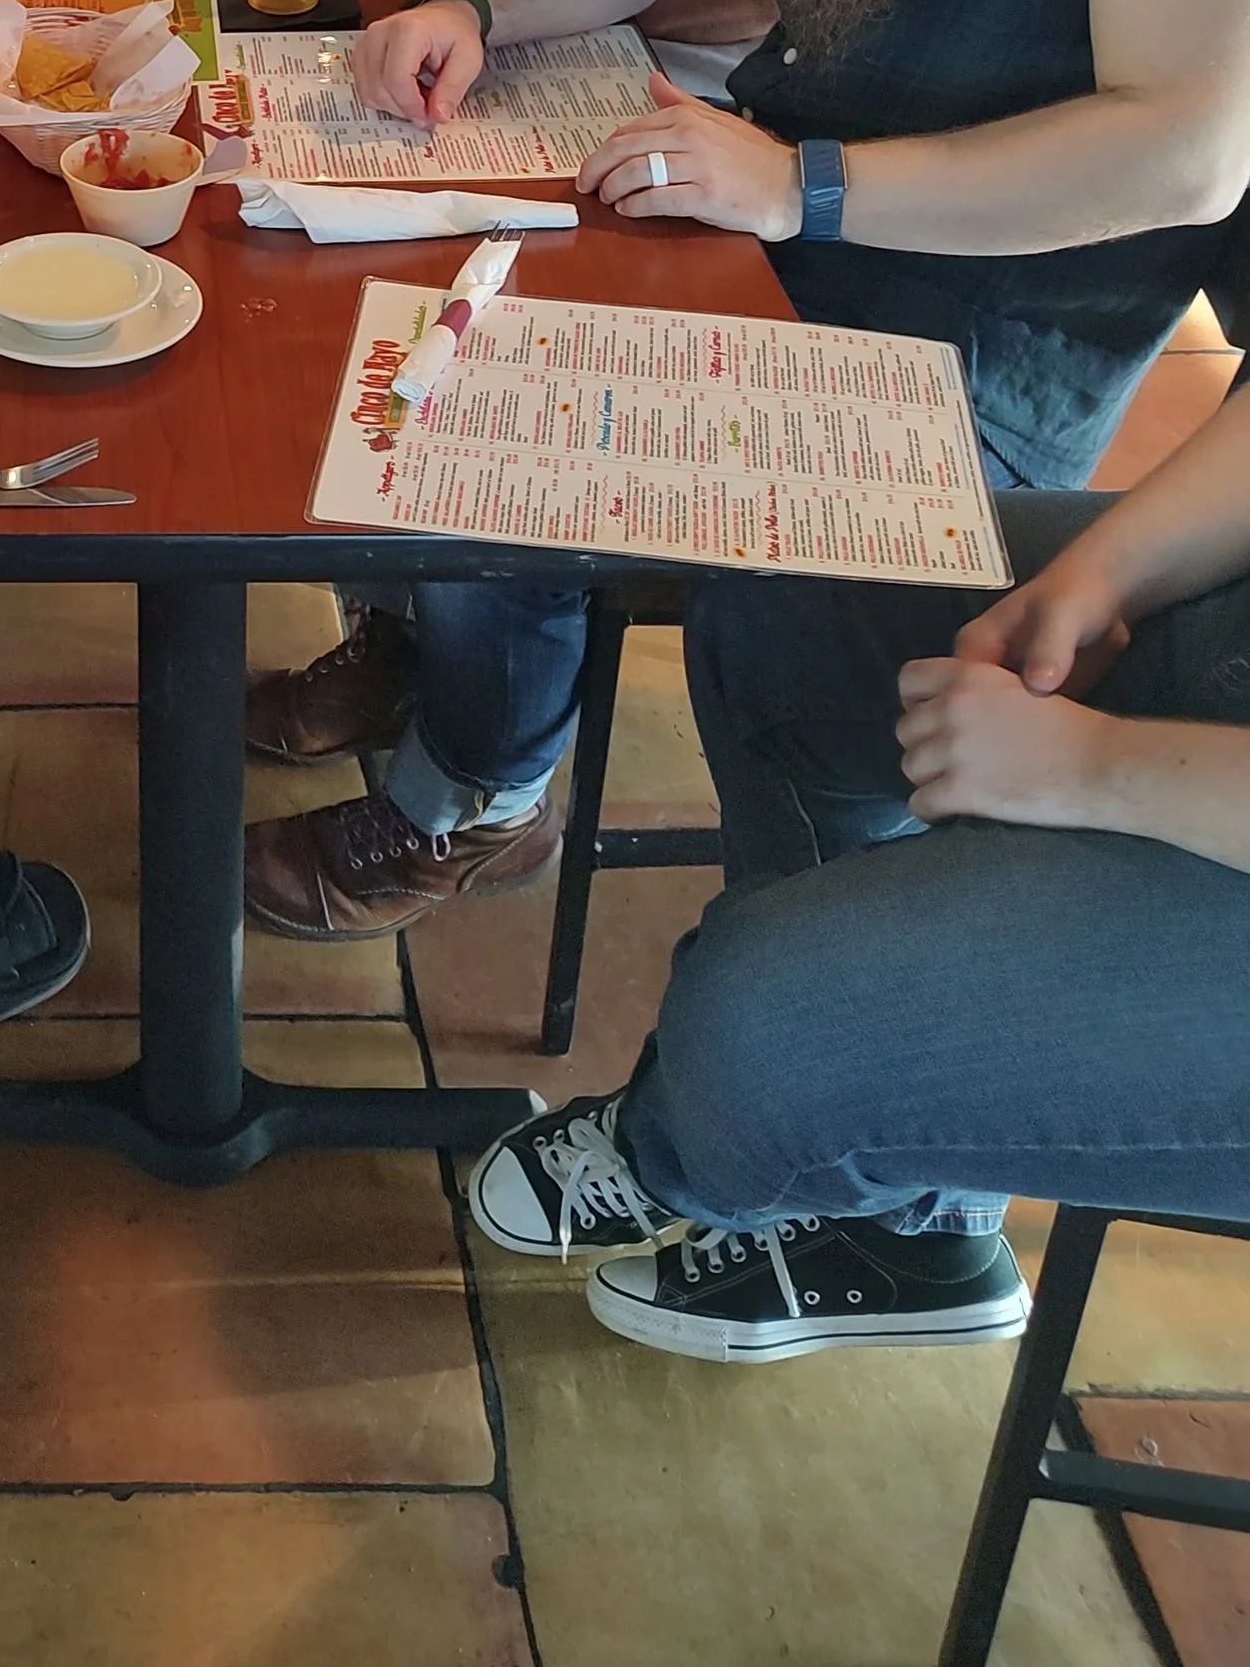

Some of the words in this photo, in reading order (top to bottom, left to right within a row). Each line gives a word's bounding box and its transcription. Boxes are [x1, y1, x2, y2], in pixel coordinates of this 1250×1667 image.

[362, 339, 410, 371] Mayo
[357, 374, 392, 390] de
[350, 391, 389, 425] Cinco
